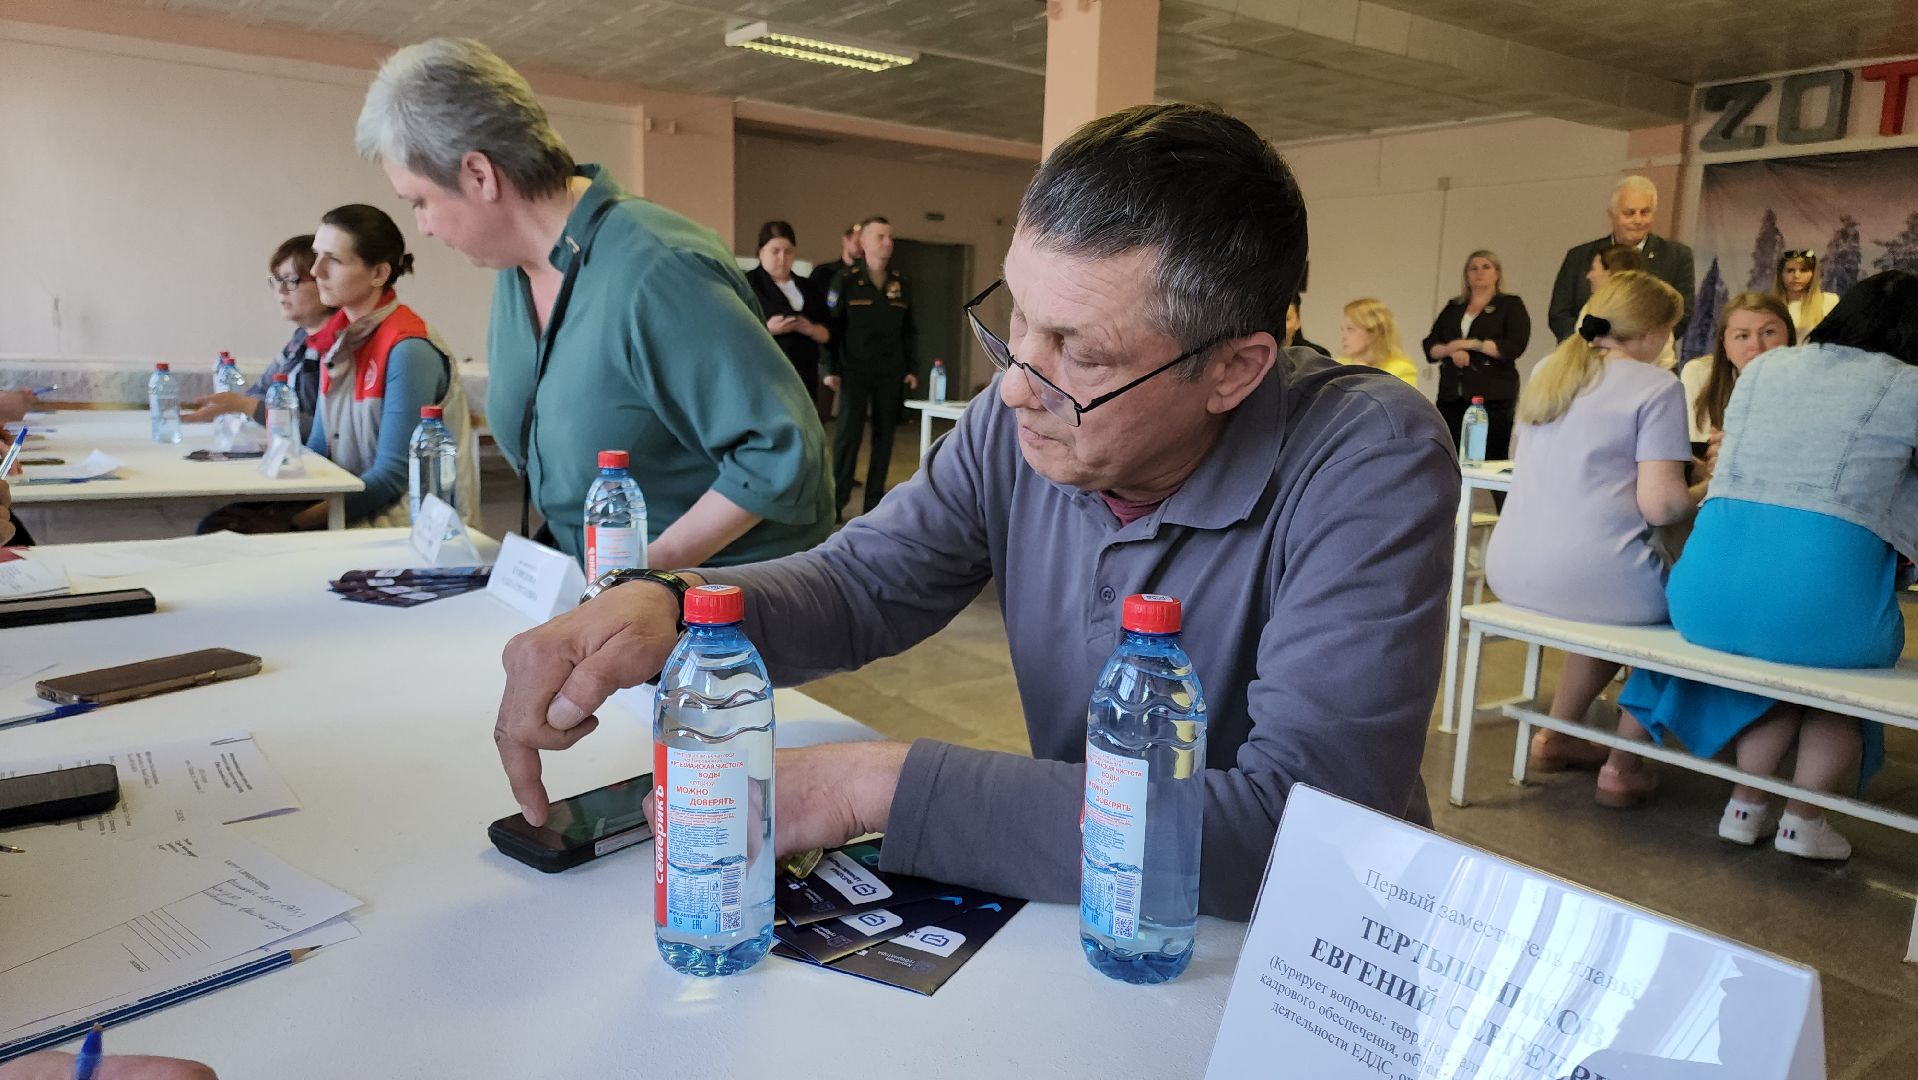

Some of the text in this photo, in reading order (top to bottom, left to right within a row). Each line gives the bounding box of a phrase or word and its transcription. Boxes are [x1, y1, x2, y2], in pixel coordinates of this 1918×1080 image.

[676, 785, 709, 796] МОЖНО
[689, 797, 735, 806] ДОВЕРЯТЬ
[1363, 868, 1437, 914] Первый
[1269, 954, 1329, 994] (Курирует
[1330, 987, 1387, 1026] вопросы:
[1309, 937, 1438, 1018] ЕВГЕНИЙ
[1260, 973, 1399, 1058] кадрового обеспечения,
[1270, 1001, 1350, 1052] деятельности
